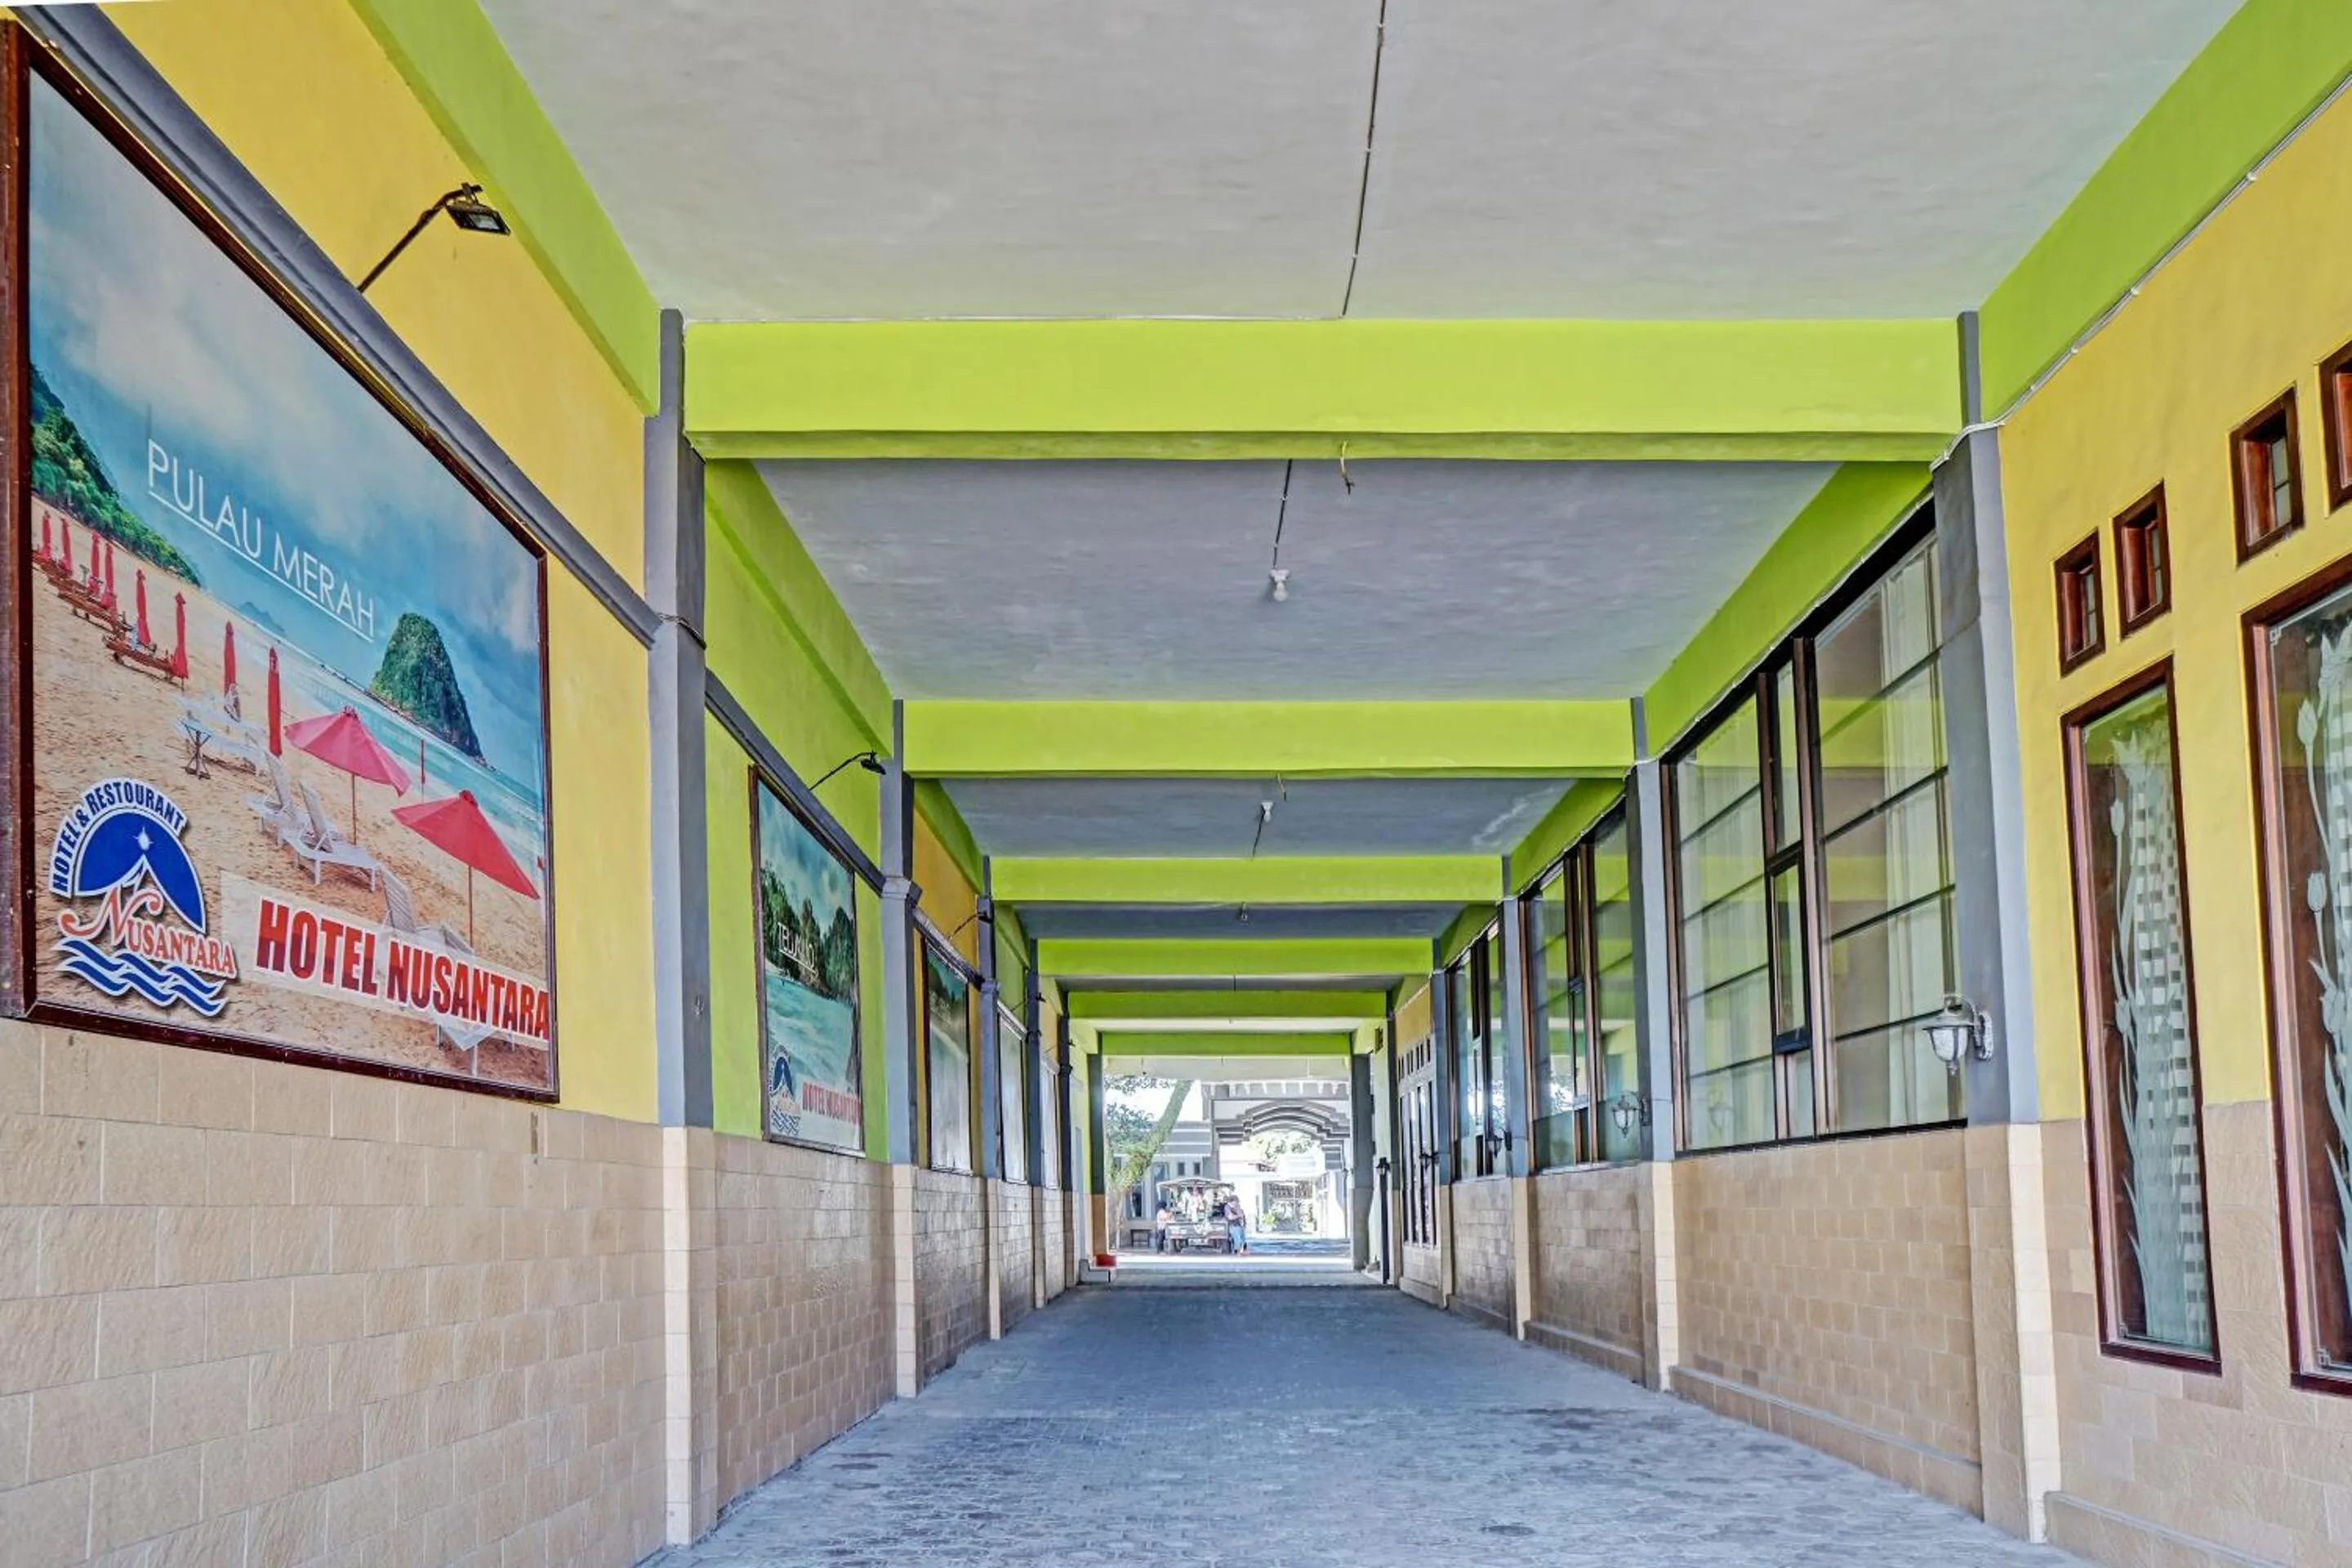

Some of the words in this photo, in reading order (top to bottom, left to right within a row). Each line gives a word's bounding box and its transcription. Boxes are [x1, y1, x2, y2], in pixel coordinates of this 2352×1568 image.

[148, 439, 261, 559] PULAU
[274, 532, 375, 638] MERAH
[52, 821, 82, 893] HOTEL
[75, 808, 89, 826] &
[84, 781, 185, 831] RESTOURANT
[256, 899, 378, 996] HOTEL
[386, 940, 550, 1040] NUSANTARA
